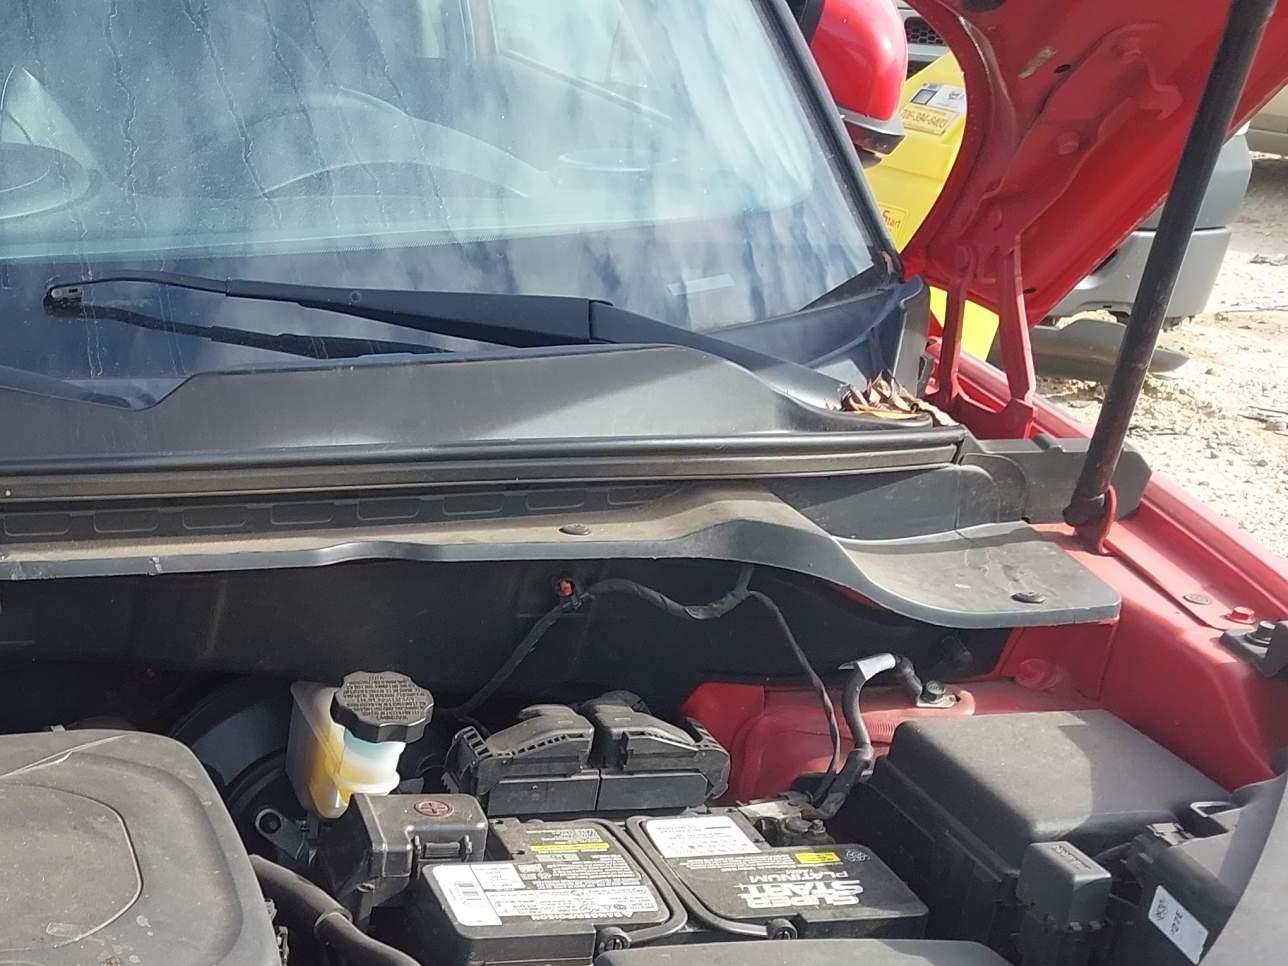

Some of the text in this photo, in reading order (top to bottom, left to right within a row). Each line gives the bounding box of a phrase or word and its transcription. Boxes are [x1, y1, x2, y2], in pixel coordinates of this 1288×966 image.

[749, 870, 849, 883] PLATINUM
[743, 880, 863, 897] START
[746, 893, 860, 909] SUPER
